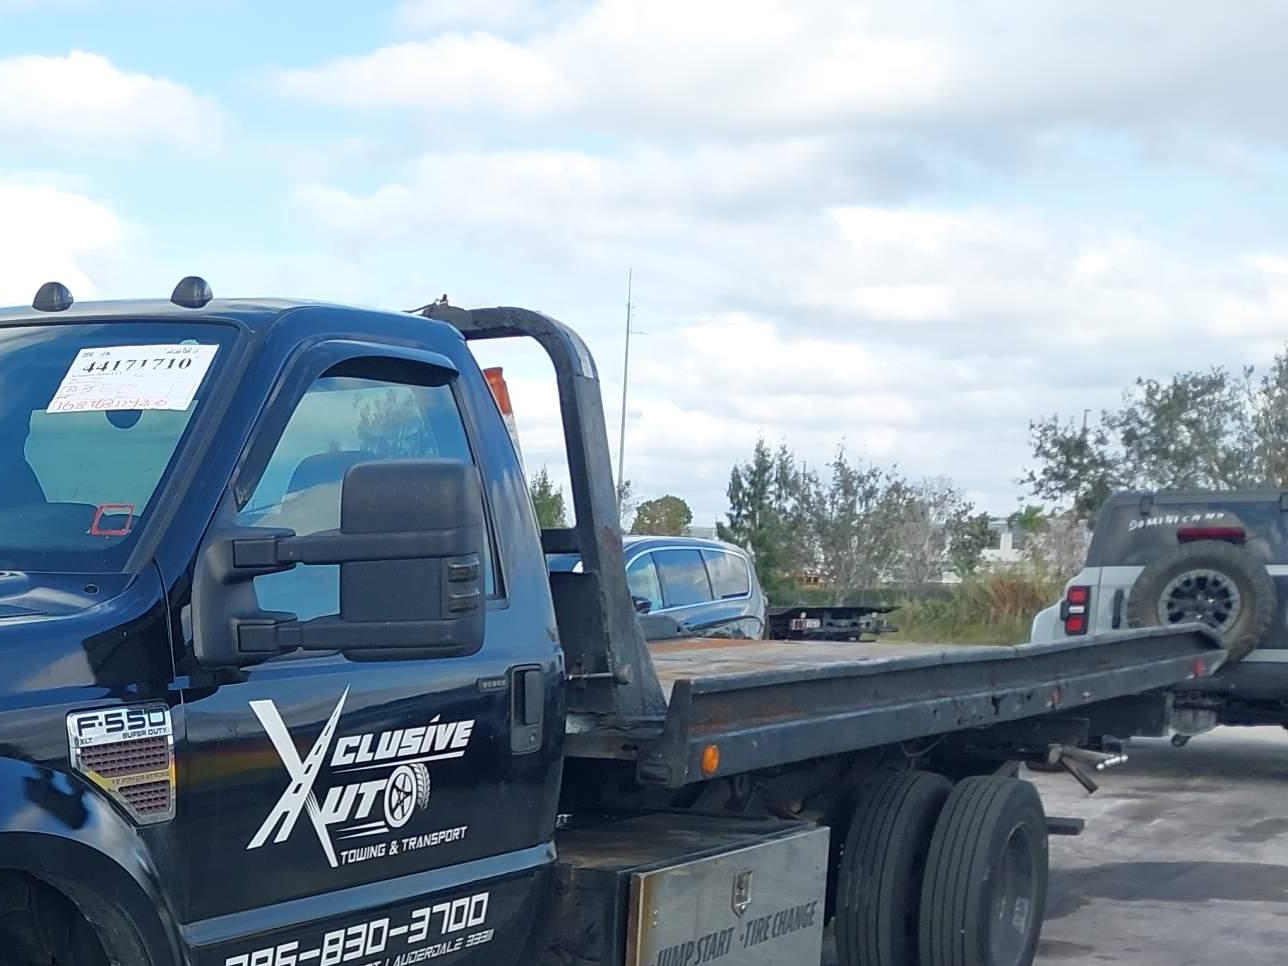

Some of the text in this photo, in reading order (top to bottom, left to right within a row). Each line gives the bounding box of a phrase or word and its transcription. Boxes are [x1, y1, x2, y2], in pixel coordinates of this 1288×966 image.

[82, 357, 193, 373] 44171710
[79, 737, 93, 746] XLT
[122, 728, 167, 740] SUPER DUTY
[340, 826, 469, 866] TOWING & TRANSPORT
[465, 928, 495, 948] 33311
[694, 926, 735, 966] START
[743, 914, 774, 949] TIRE
[772, 900, 818, 940] CHANGE
